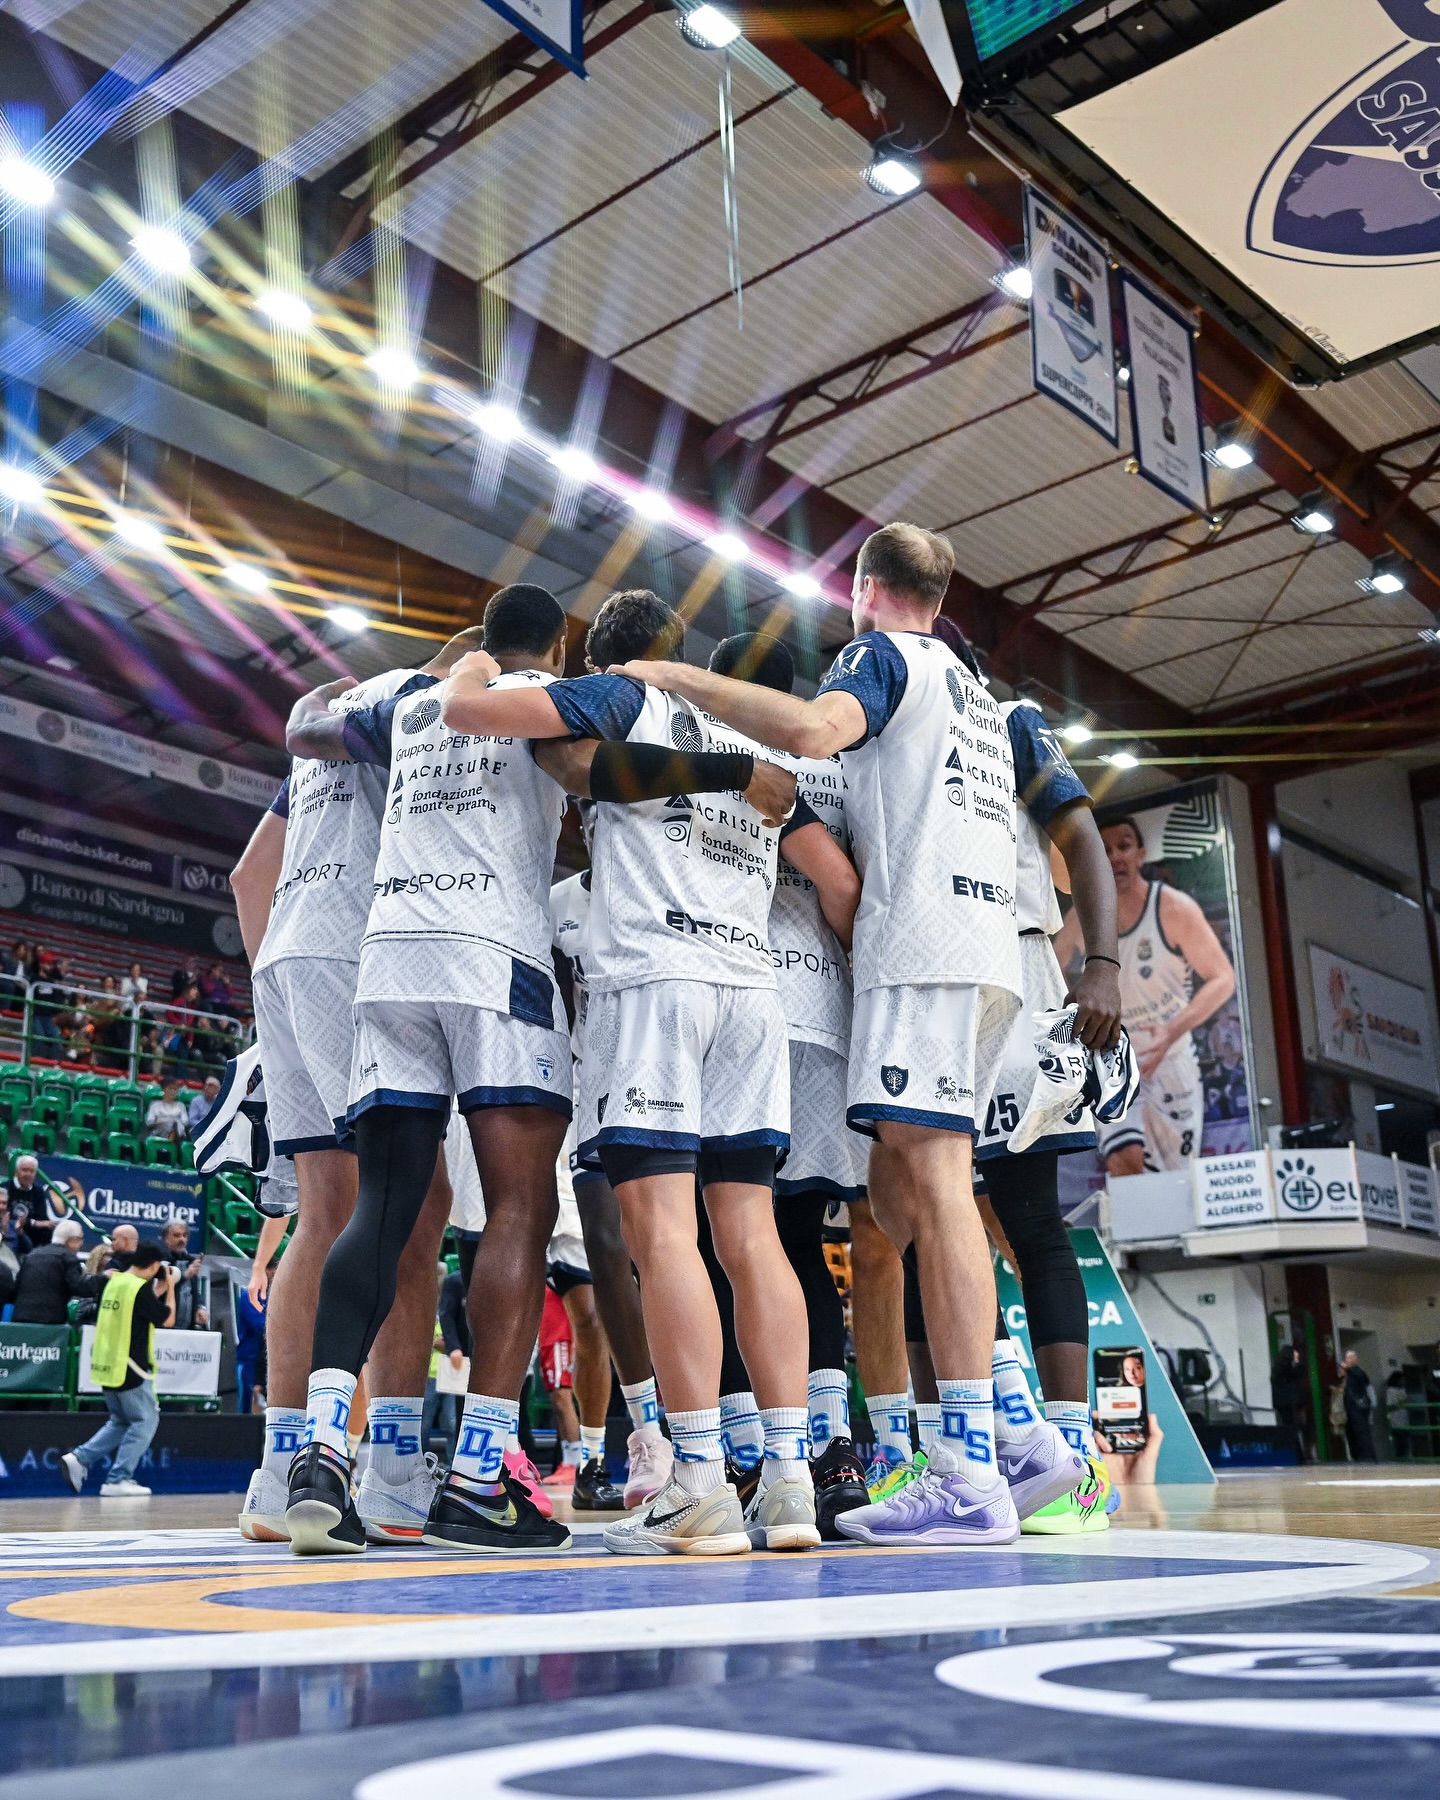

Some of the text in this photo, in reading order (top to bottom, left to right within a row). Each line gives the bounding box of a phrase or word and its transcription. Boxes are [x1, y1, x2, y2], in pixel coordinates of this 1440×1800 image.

[396, 743, 434, 762] Gruppo
[438, 735, 471, 752] BPER
[977, 739, 999, 760] BPER
[411, 785, 483, 803] fondazione
[408, 797, 497, 816] mont'e prama
[16, 826, 154, 873] dinamobasket.com
[32, 873, 87, 905] Banco
[107, 890, 185, 926] Sardegna
[647, 1099, 685, 1109] SARDEGNA
[984, 1092, 1020, 1138] 25
[1204, 1159, 1257, 1174] SASSARI
[1209, 1173, 1254, 1187] NUORO
[1204, 1187, 1262, 1203] CAGLIARI
[88, 1186, 200, 1224] Character
[1206, 1201, 1264, 1217] ALGHERO
[164, 1348, 213, 1364] Sardegna
